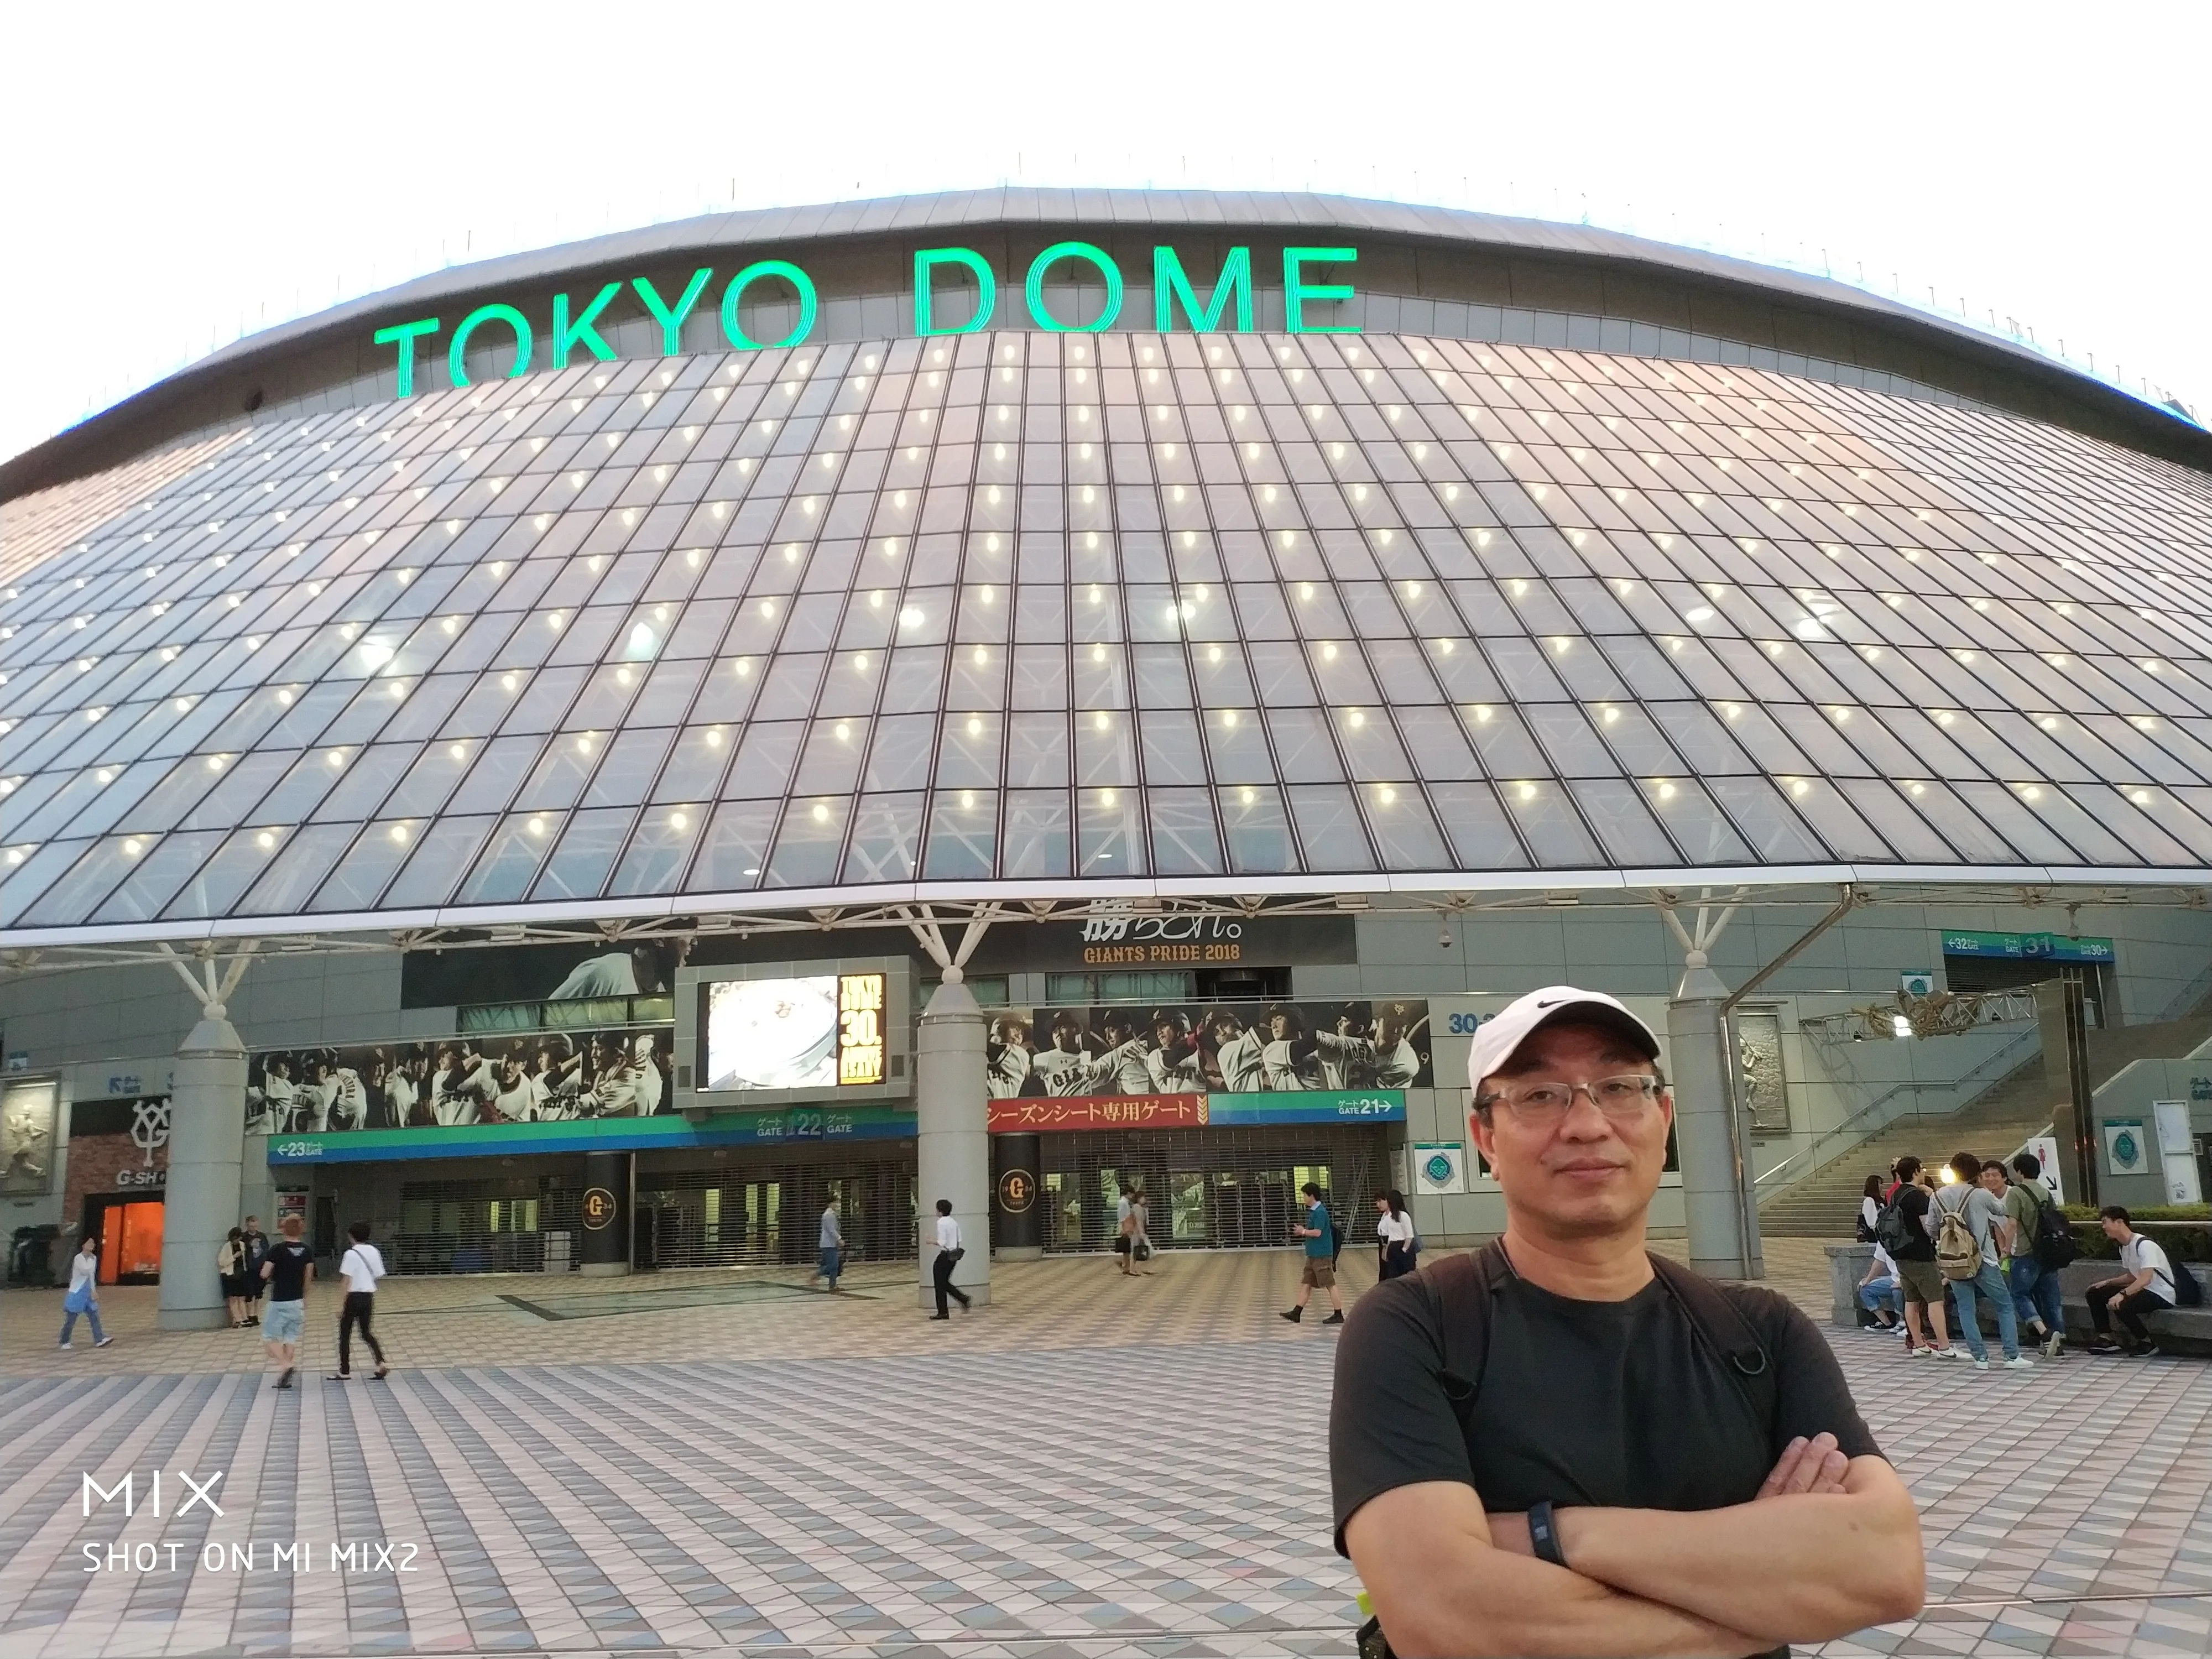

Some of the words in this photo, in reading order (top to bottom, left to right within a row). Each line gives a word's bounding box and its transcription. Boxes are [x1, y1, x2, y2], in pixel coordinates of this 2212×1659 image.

[374, 259, 817, 399] TOKYO
[914, 242, 1361, 336] DOME
[1955, 938, 1968, 950] 32
[2025, 936, 2051, 954] 31
[1084, 945, 1145, 963] GIANTS
[1150, 945, 1201, 962] PRIDE
[1205, 944, 1240, 961] 2018
[1360, 1099, 1379, 1114] 21
[757, 1127, 783, 1137] GATE
[798, 1113, 821, 1135] 22
[826, 1124, 853, 1134] GATE
[288, 1141, 305, 1157] 23
